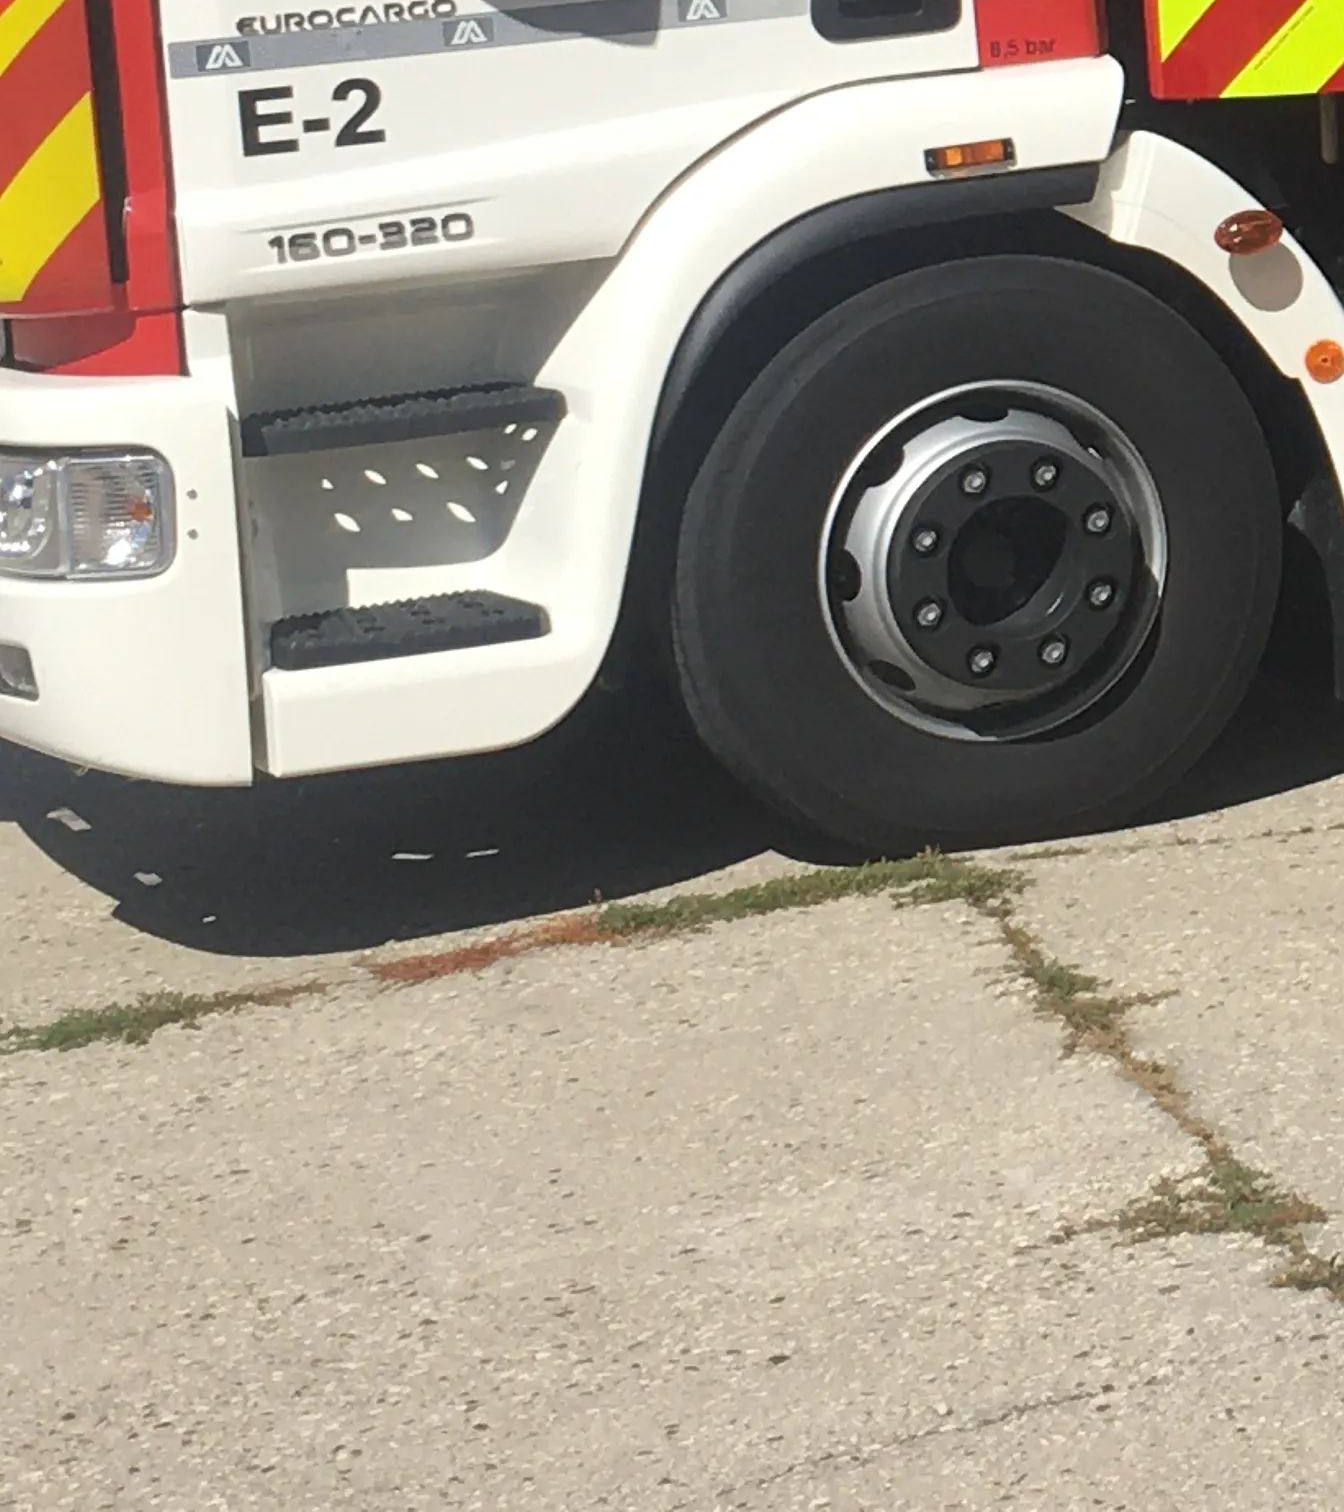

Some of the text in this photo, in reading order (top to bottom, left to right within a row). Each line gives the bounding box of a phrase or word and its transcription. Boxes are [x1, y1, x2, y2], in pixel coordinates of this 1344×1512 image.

[1024, 37, 1057, 56] bar
[237, 77, 386, 157] E-2
[268, 212, 474, 264] 160-320
